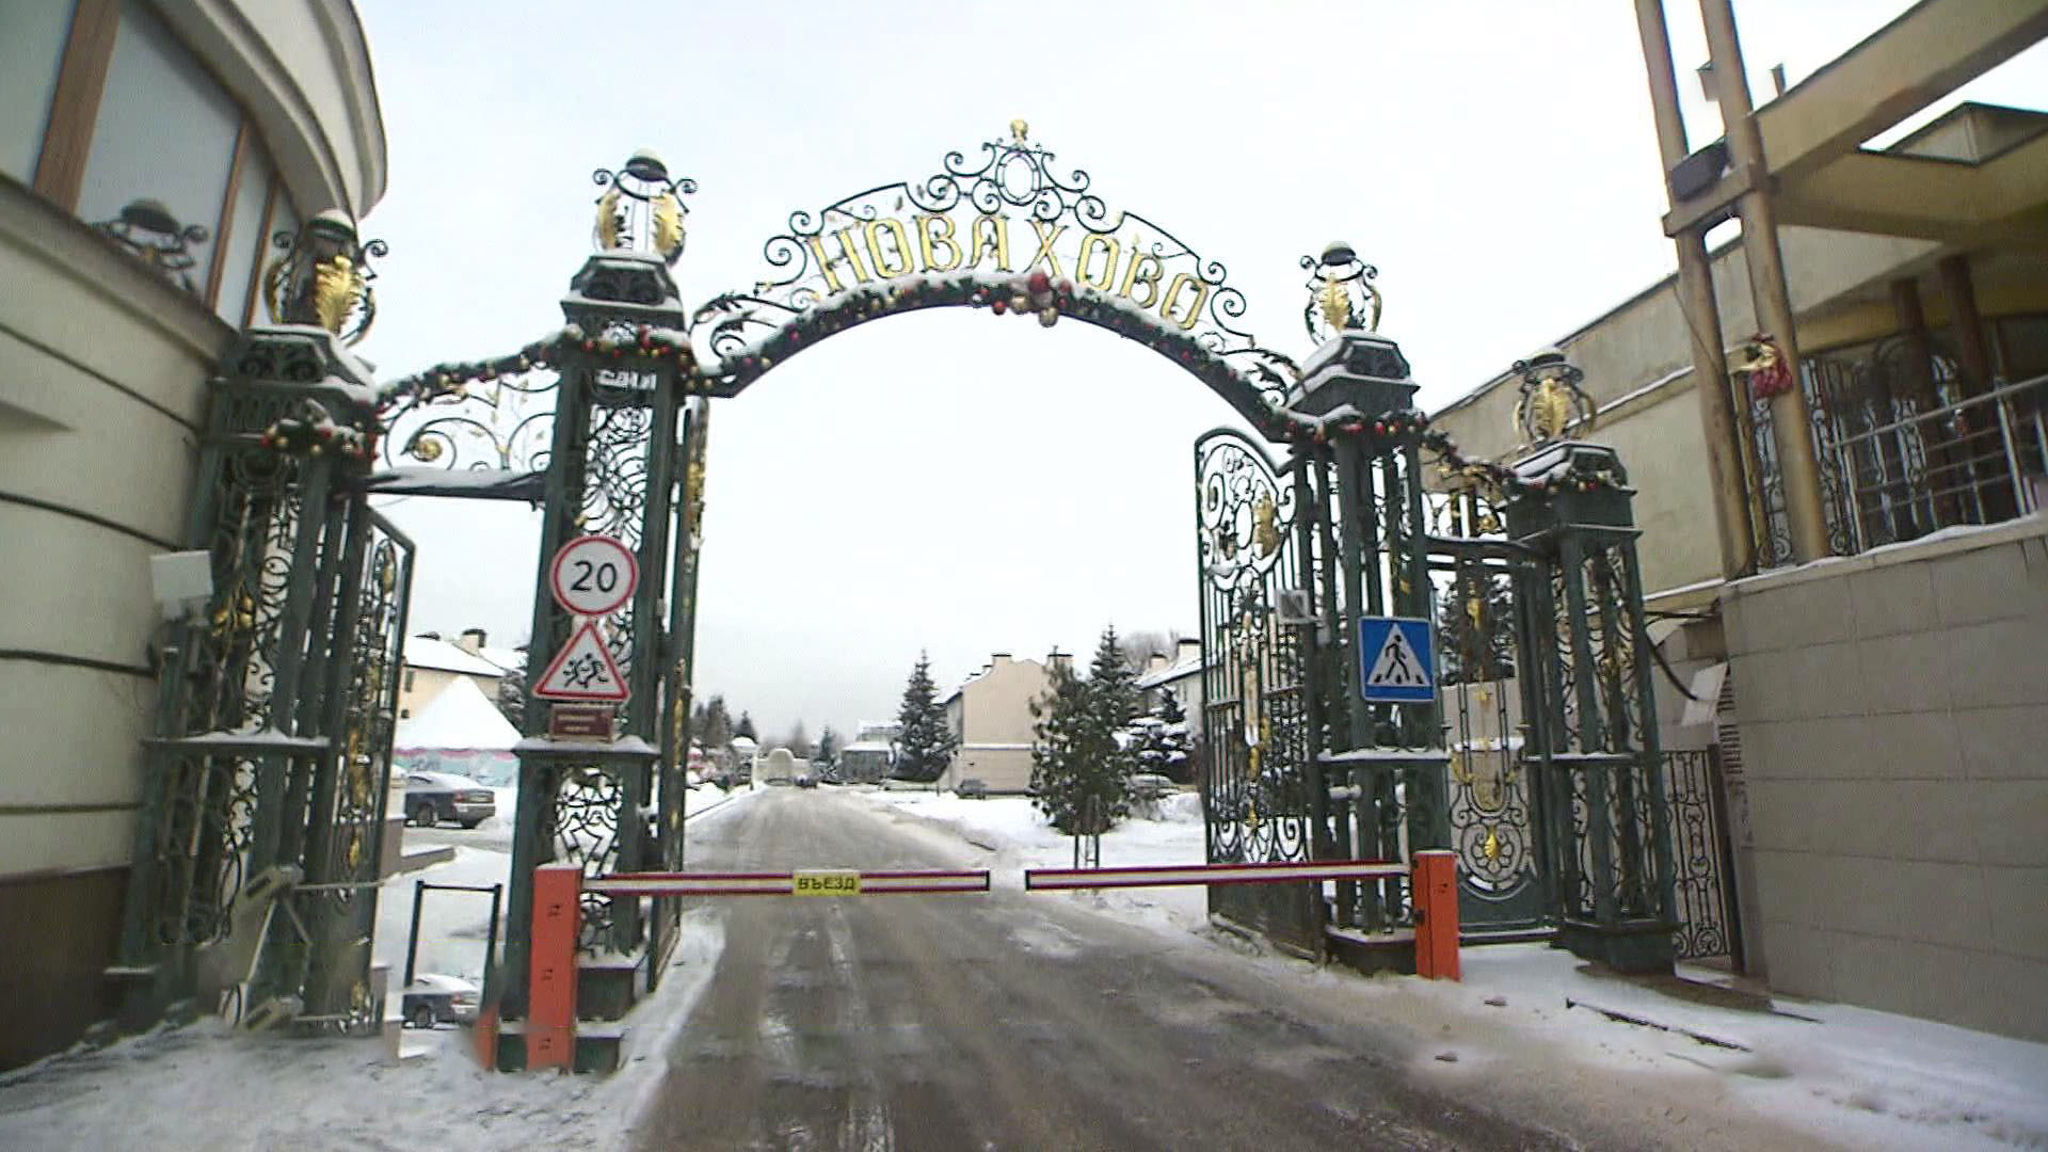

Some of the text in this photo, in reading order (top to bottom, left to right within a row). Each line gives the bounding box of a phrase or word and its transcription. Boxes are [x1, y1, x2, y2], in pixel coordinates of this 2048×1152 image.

[808, 211, 1209, 331] НОВАХОВО
[571, 560, 617, 592] 20
[798, 877, 855, 890] ВЪЕЗД
